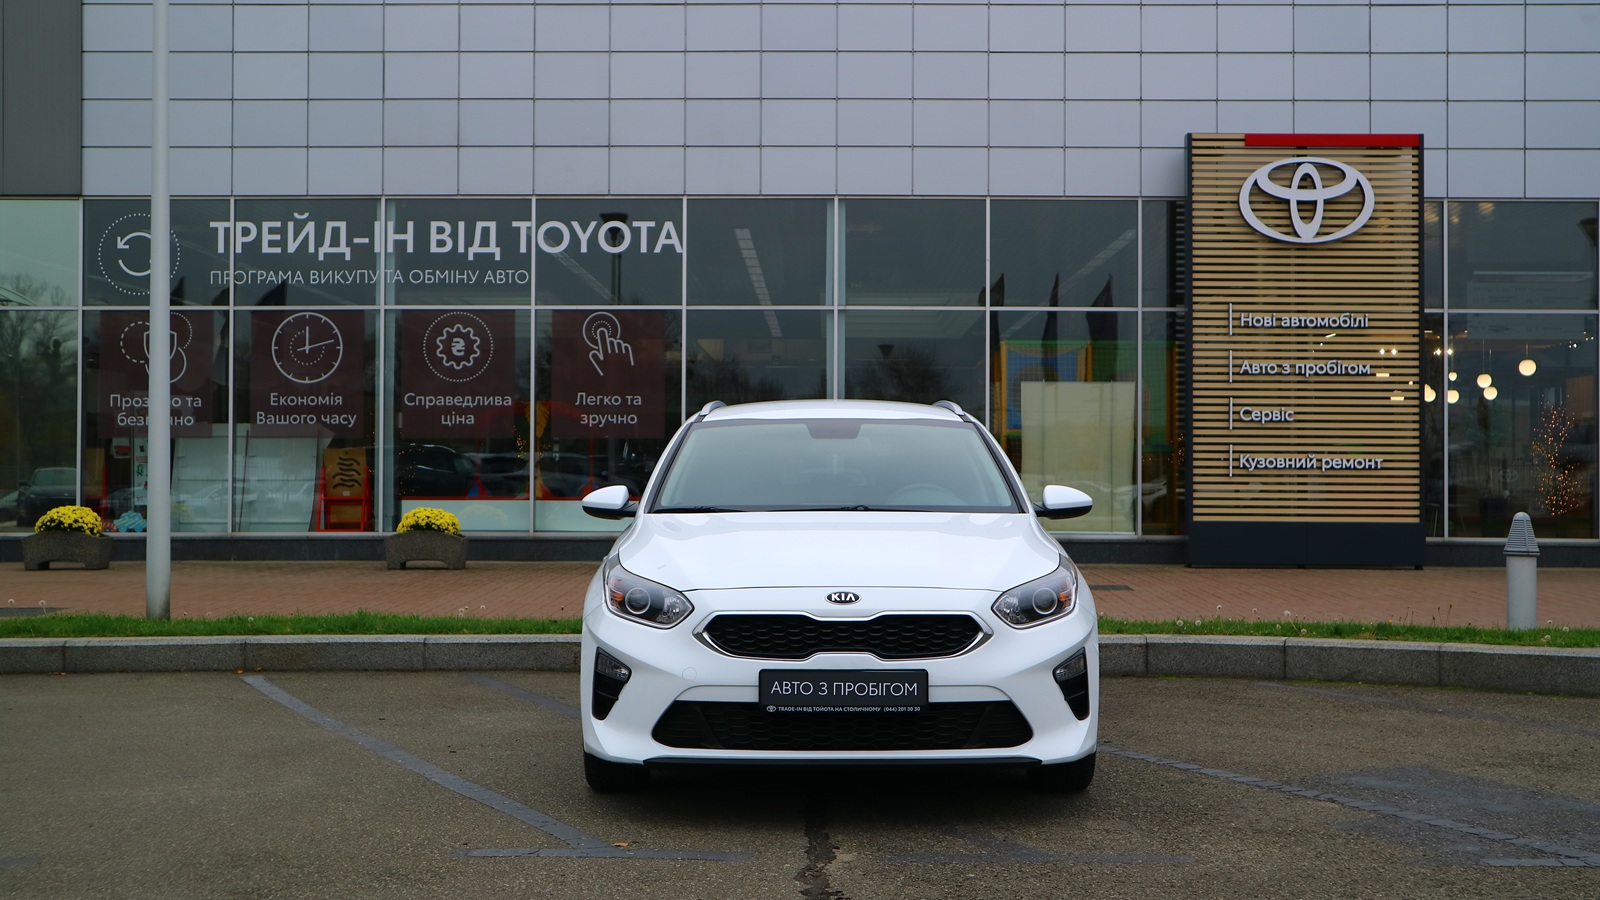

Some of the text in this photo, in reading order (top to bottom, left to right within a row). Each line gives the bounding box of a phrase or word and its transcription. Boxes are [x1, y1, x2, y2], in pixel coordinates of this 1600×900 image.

[210, 212, 683, 261] ТРЕЙД-ІН ВІД TOYOTA
[210, 270, 529, 284] ПРОГРАМА ВИКУПУ ТА ОБМІНУ АВТО
[1240, 313, 1369, 328] Нові автомобілі
[1240, 360, 1370, 378] Авто з пробігом
[110, 394, 202, 410] Прозо та
[270, 393, 342, 406] Економія
[404, 393, 512, 410] Справедлива
[574, 393, 642, 407] Легко та
[117, 412, 193, 425] безно
[257, 412, 356, 428] Вашого часу
[441, 412, 474, 426] ціна
[580, 413, 638, 428] зручно
[1240, 407, 1295, 424] Сервіс
[1240, 454, 1383, 471] Кузовний ремонт
[831, 593, 855, 601] KIA
[771, 681, 917, 696] АВТО З ПРОБІГОМ
